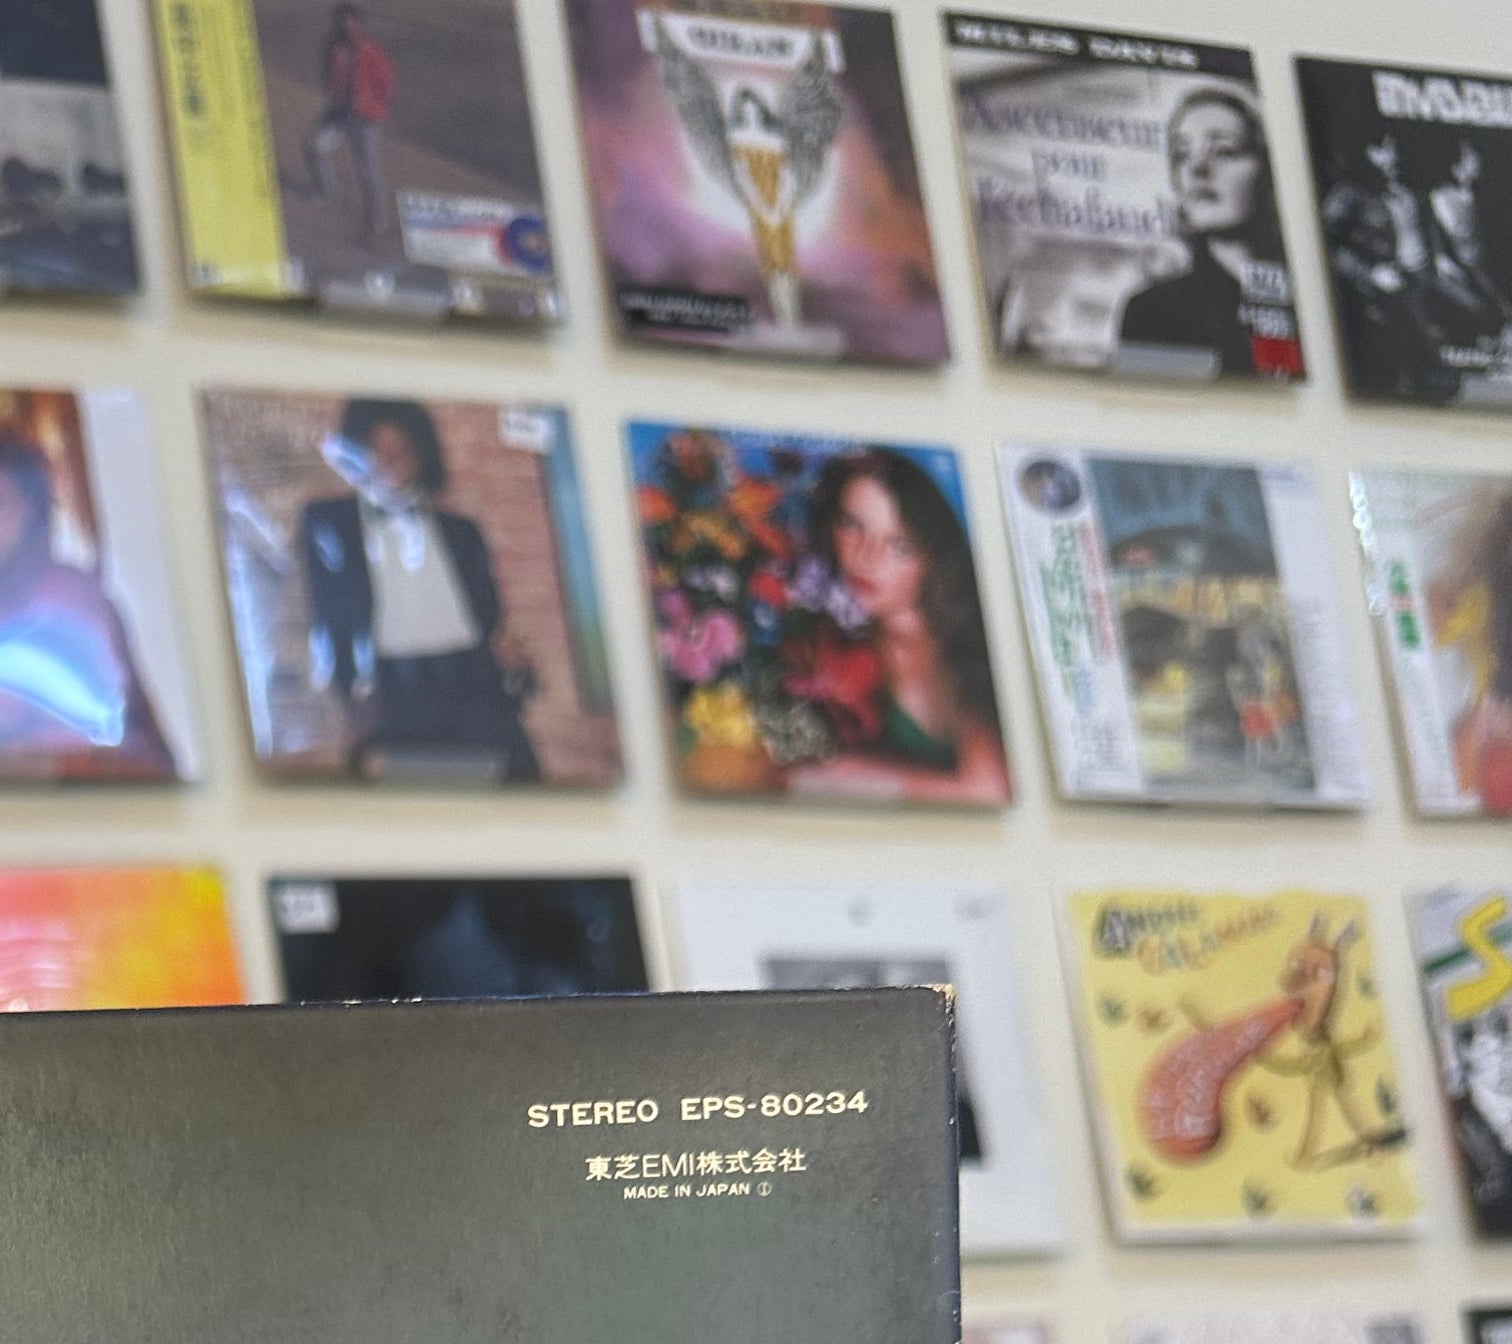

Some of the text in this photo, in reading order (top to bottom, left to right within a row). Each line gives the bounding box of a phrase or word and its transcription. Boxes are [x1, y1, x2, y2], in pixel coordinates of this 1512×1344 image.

[526, 1090, 869, 1129] STEREO EPS-80234
[584, 1146, 808, 1182] 東芝EMI株式会社
[623, 1185, 670, 1200] MADE
[674, 1184, 692, 1198] IN
[695, 1182, 752, 1198] JAPAN
